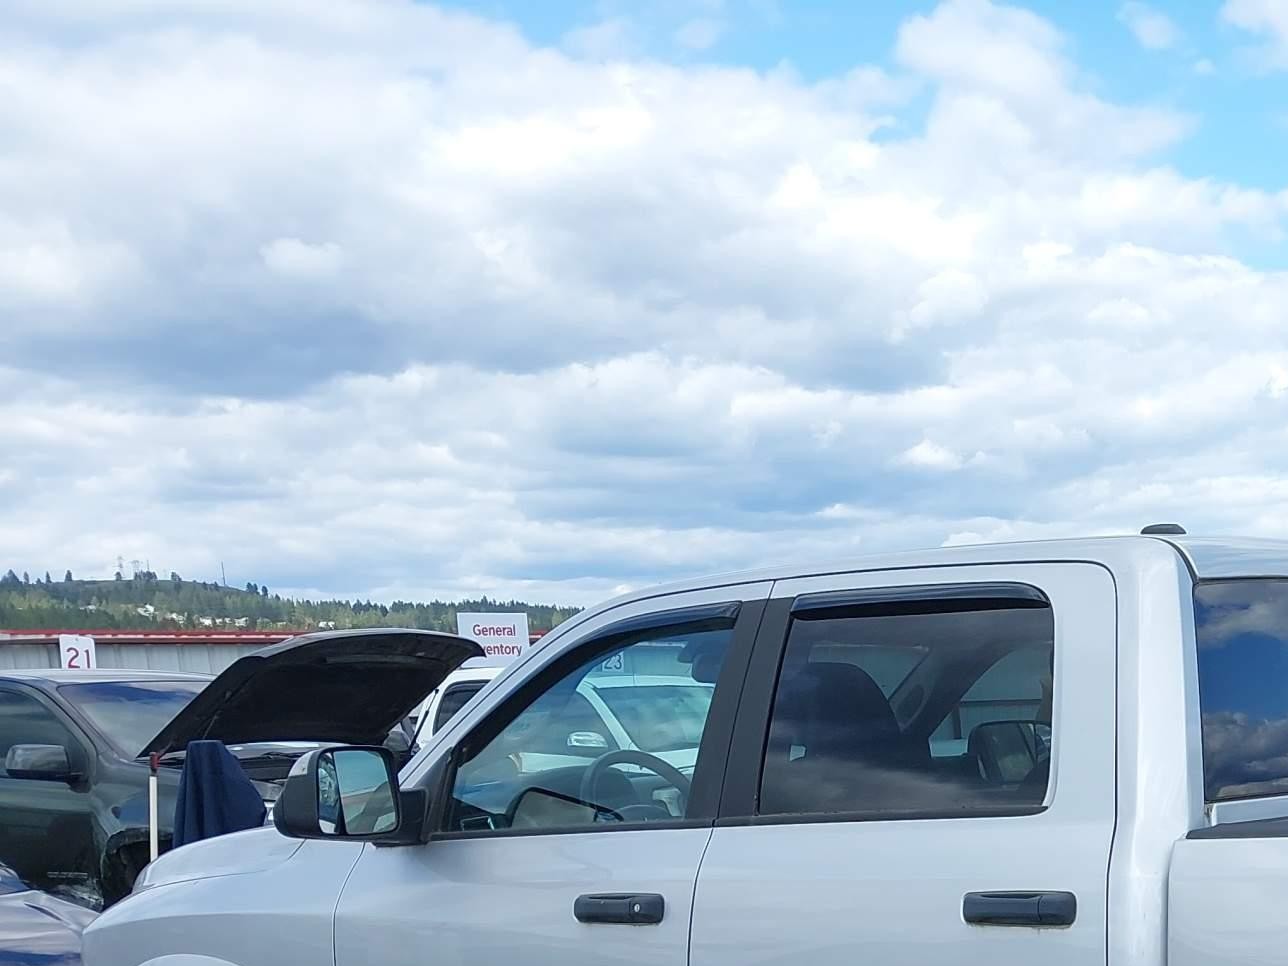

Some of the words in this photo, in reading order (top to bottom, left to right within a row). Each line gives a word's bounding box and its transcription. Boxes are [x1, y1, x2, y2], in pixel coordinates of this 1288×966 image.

[472, 623, 516, 637] General
[483, 643, 523, 657] entory
[66, 647, 91, 669] 21
[603, 654, 624, 671] 23
